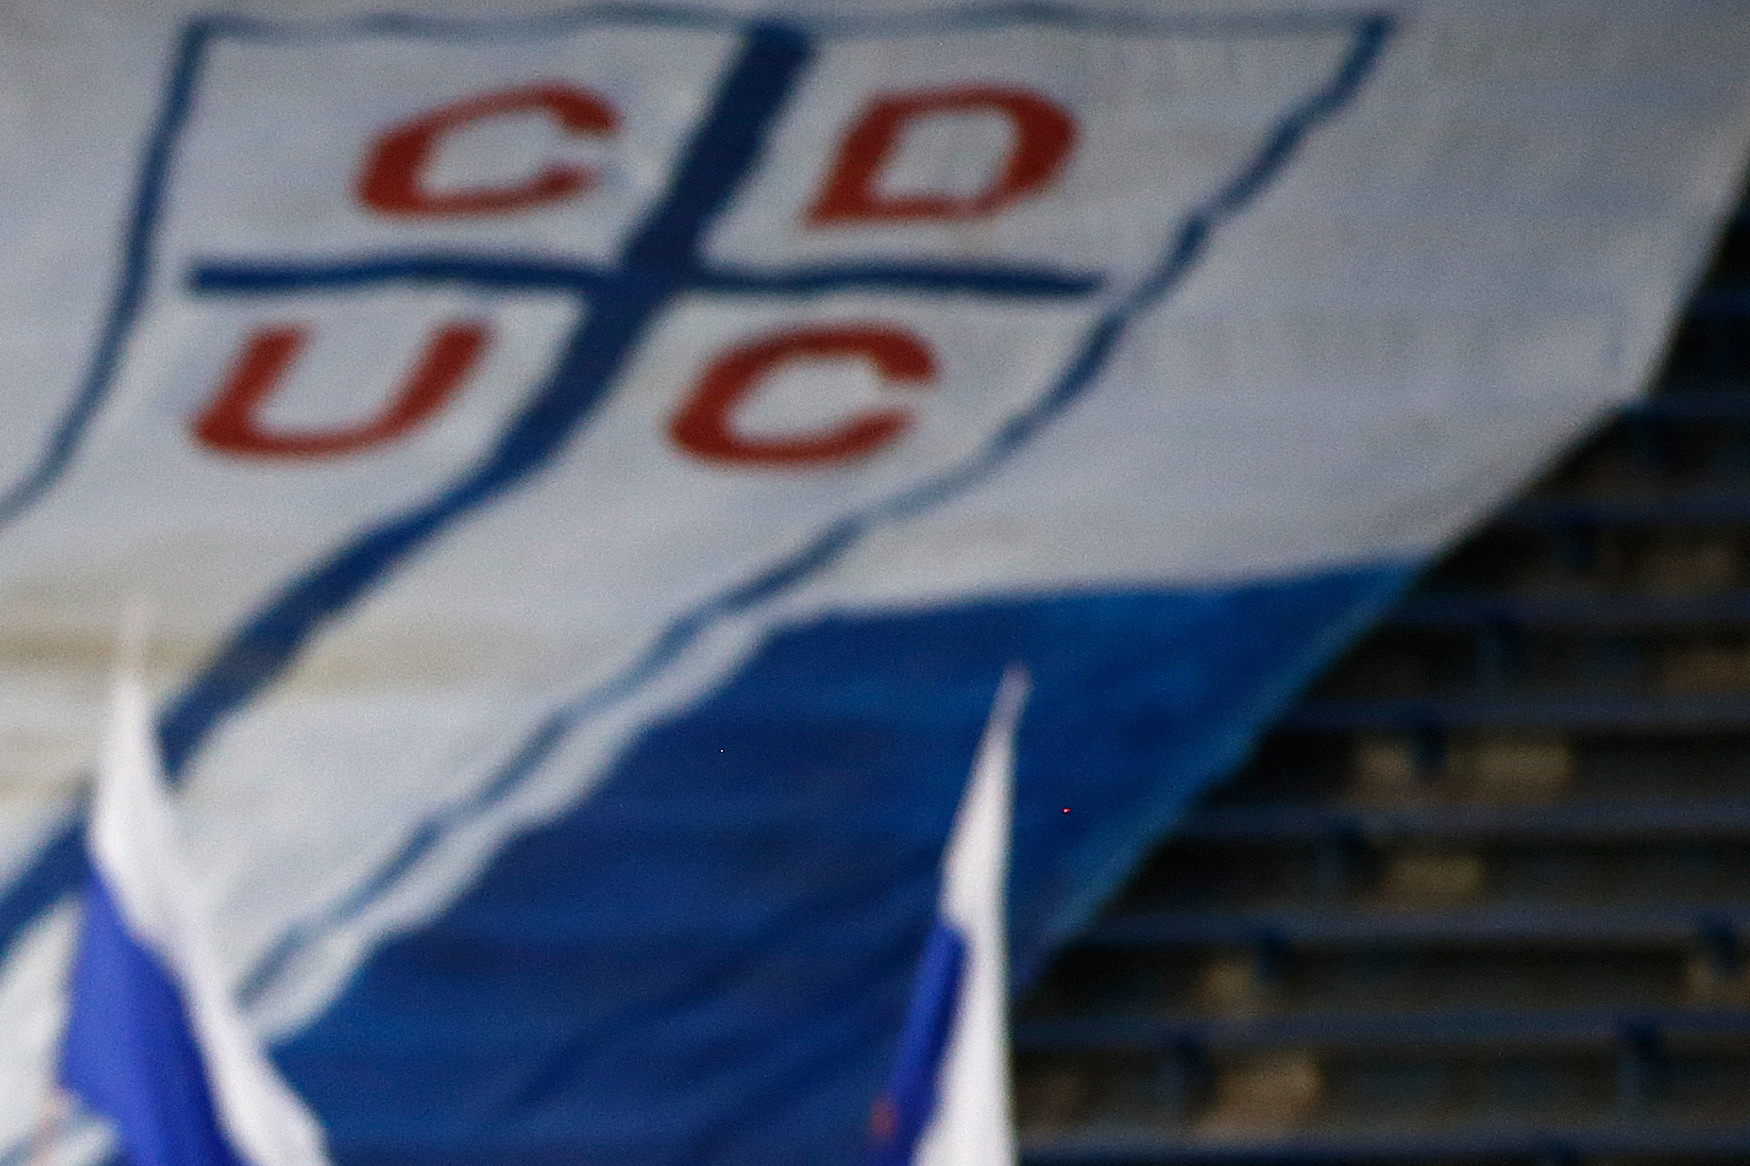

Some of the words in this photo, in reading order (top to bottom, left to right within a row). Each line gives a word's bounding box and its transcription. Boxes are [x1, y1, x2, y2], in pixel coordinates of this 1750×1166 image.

[353, 81, 624, 221] C
[801, 80, 1081, 229] D
[187, 318, 499, 459] U
[667, 318, 940, 467] C
